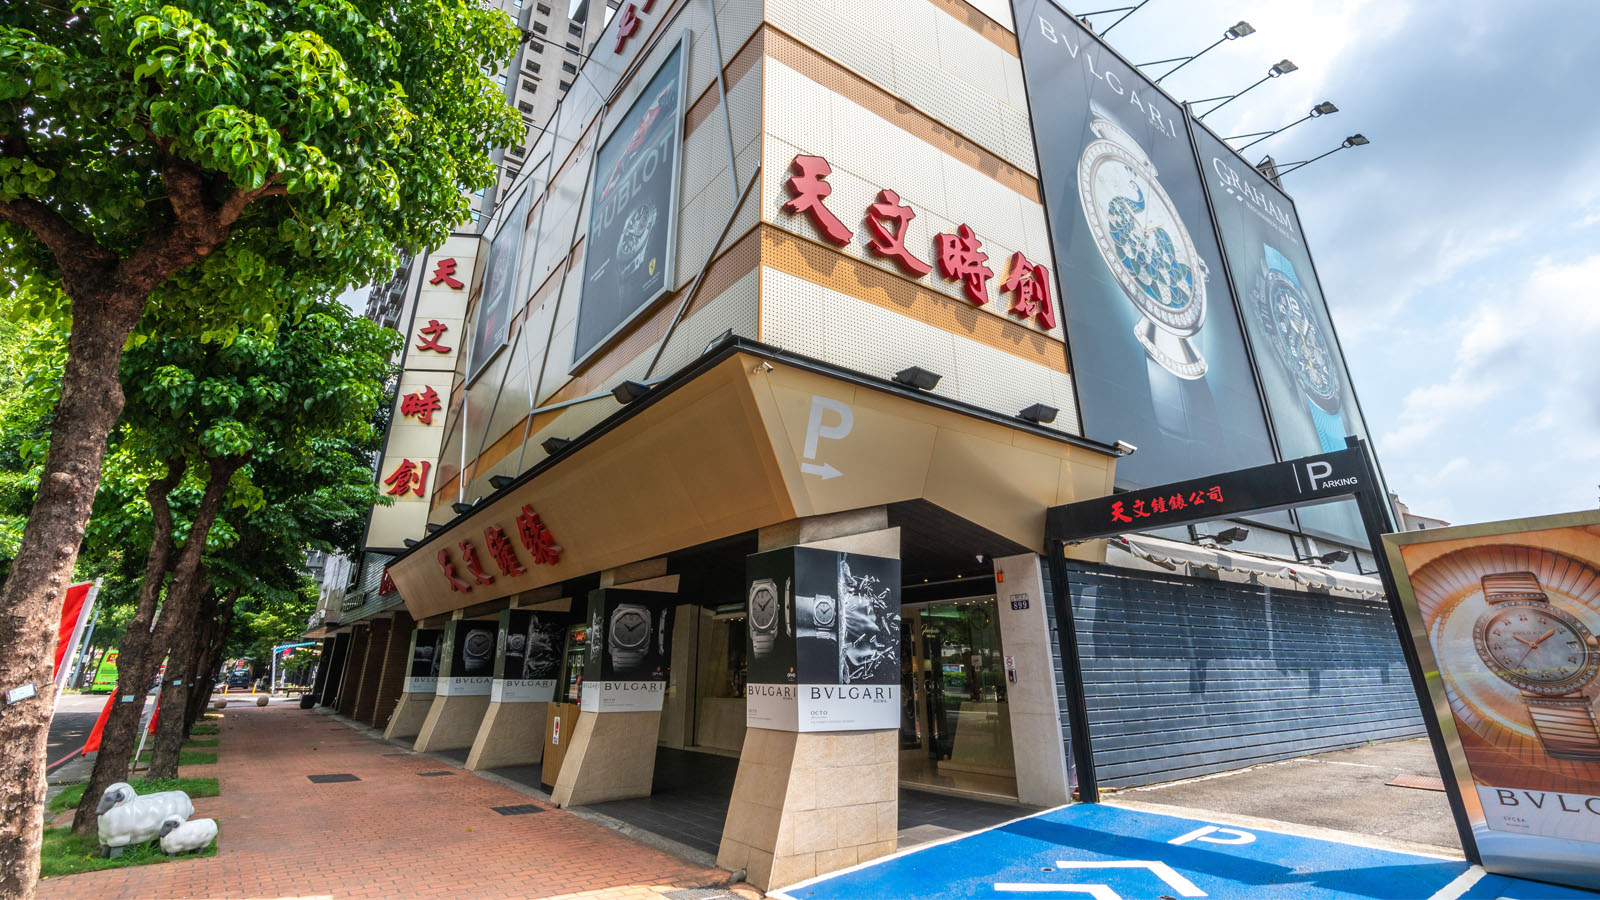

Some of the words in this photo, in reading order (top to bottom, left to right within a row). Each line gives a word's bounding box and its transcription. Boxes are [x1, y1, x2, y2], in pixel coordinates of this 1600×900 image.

[1038, 15, 1177, 138] BVLGARI
[590, 128, 675, 247] HUBLOT
[1213, 157, 1294, 233] GRAHAM
[782, 154, 1056, 331] 天文時創
[384, 258, 465, 497] 天文時創
[803, 395, 854, 460] P
[1013, 600, 1027, 610] 899
[604, 682, 663, 691] BVLGARI
[748, 685, 796, 698] BVLGARI
[811, 687, 892, 700] BVLGARI
